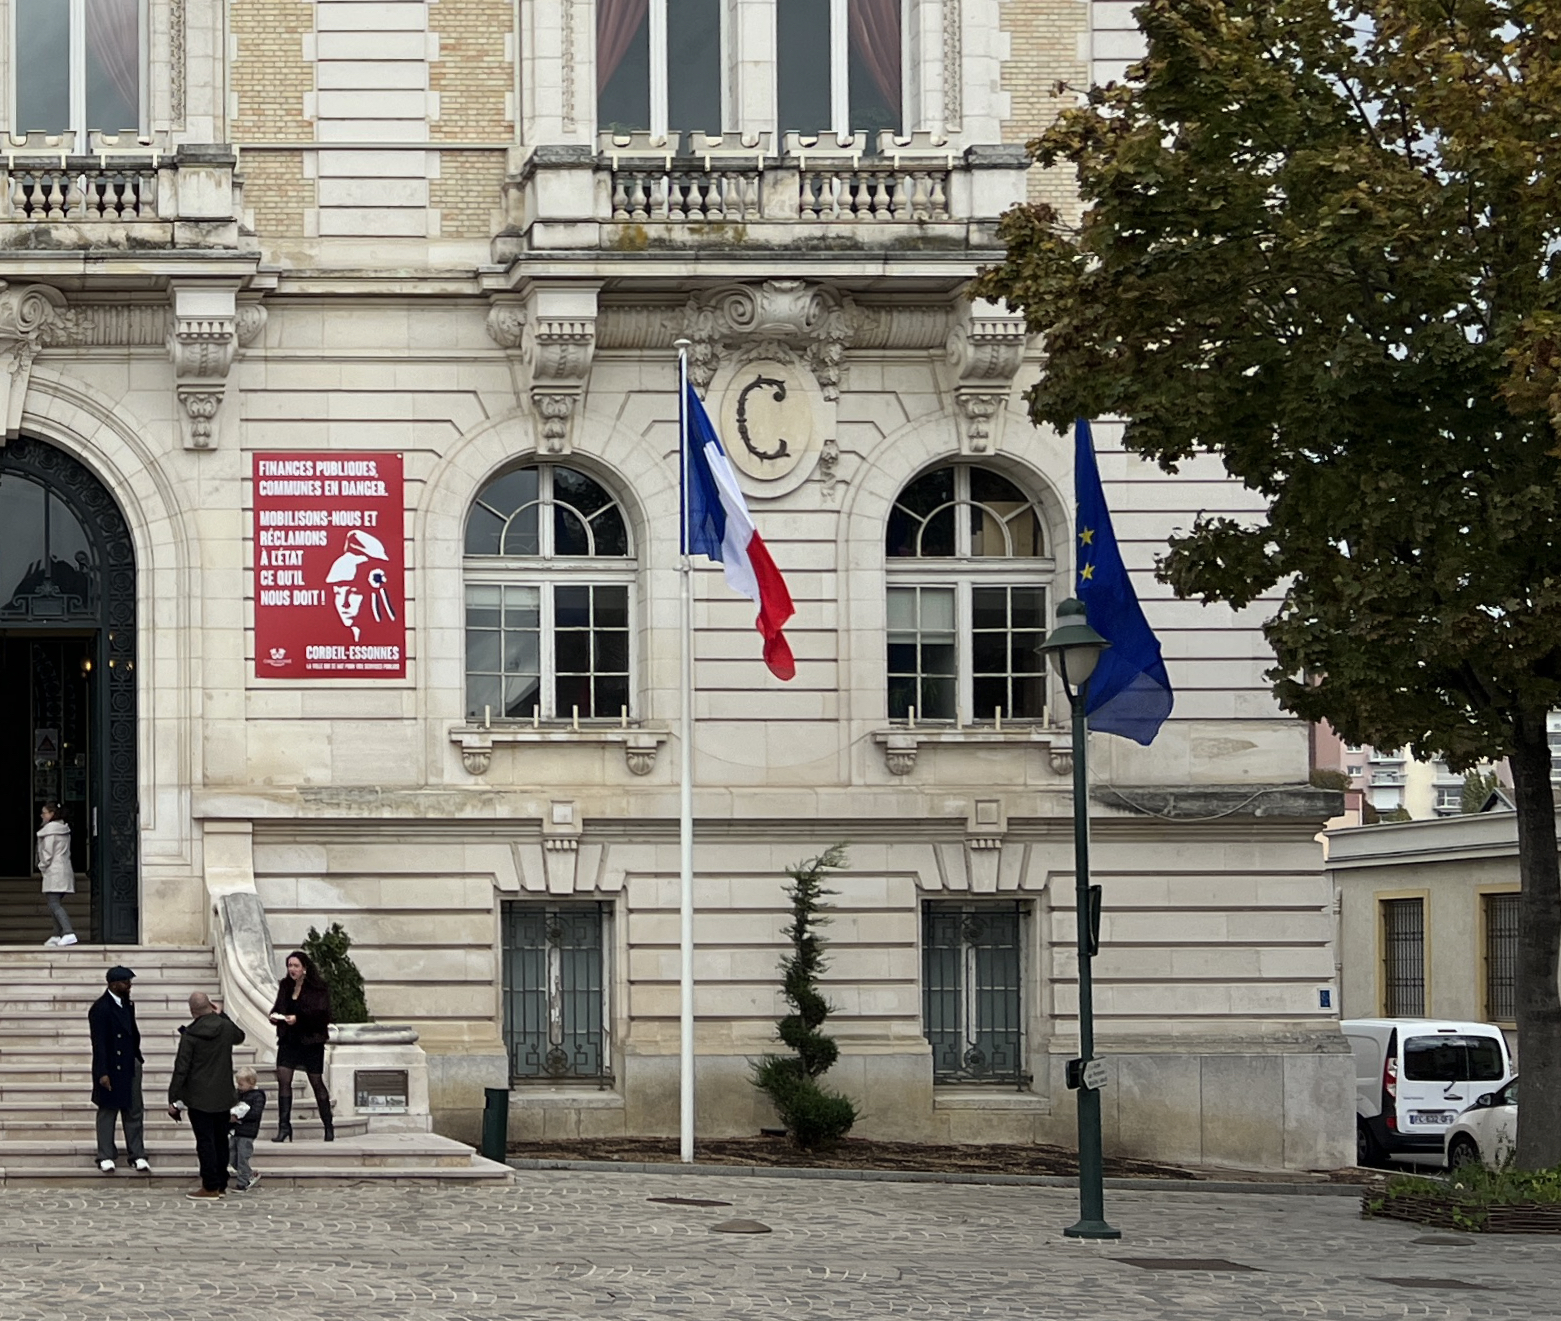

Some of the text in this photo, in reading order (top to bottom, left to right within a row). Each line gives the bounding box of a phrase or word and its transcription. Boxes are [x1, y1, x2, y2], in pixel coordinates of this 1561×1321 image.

[259, 460, 378, 479] FINANCES PUBLIQUES,
[259, 480, 388, 497] COMMUNES EN DANGER.
[259, 510, 378, 527] MOBILISONS-NOUS ET
[259, 528, 328, 546] RÉCLAMONS
[259, 547, 304, 566] À L'ÉTAT
[260, 569, 306, 586] CE QU'IL
[260, 589, 291, 606] NOUS
[292, 589, 319, 606] DOIT
[305, 645, 400, 660] CORBEIL-ESSONNES
